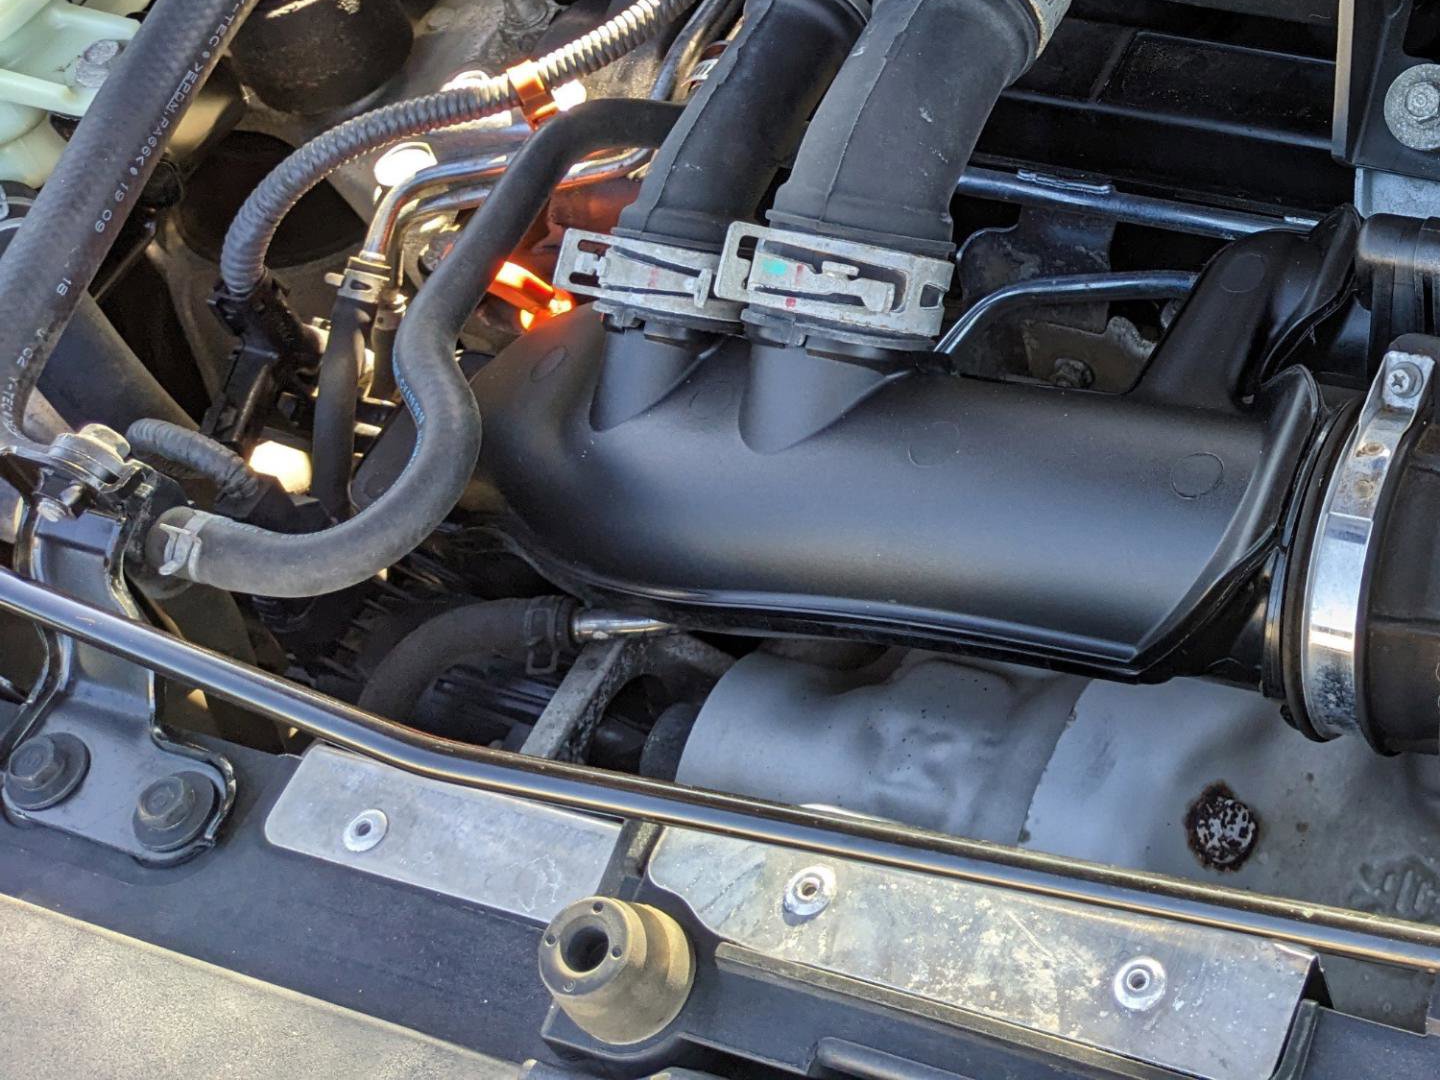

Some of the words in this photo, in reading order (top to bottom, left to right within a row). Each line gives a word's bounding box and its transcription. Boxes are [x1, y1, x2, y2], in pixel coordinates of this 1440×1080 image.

[114, 182, 129, 202] 19
[95, 209, 113, 233] 09
[56, 277, 72, 296] 18
